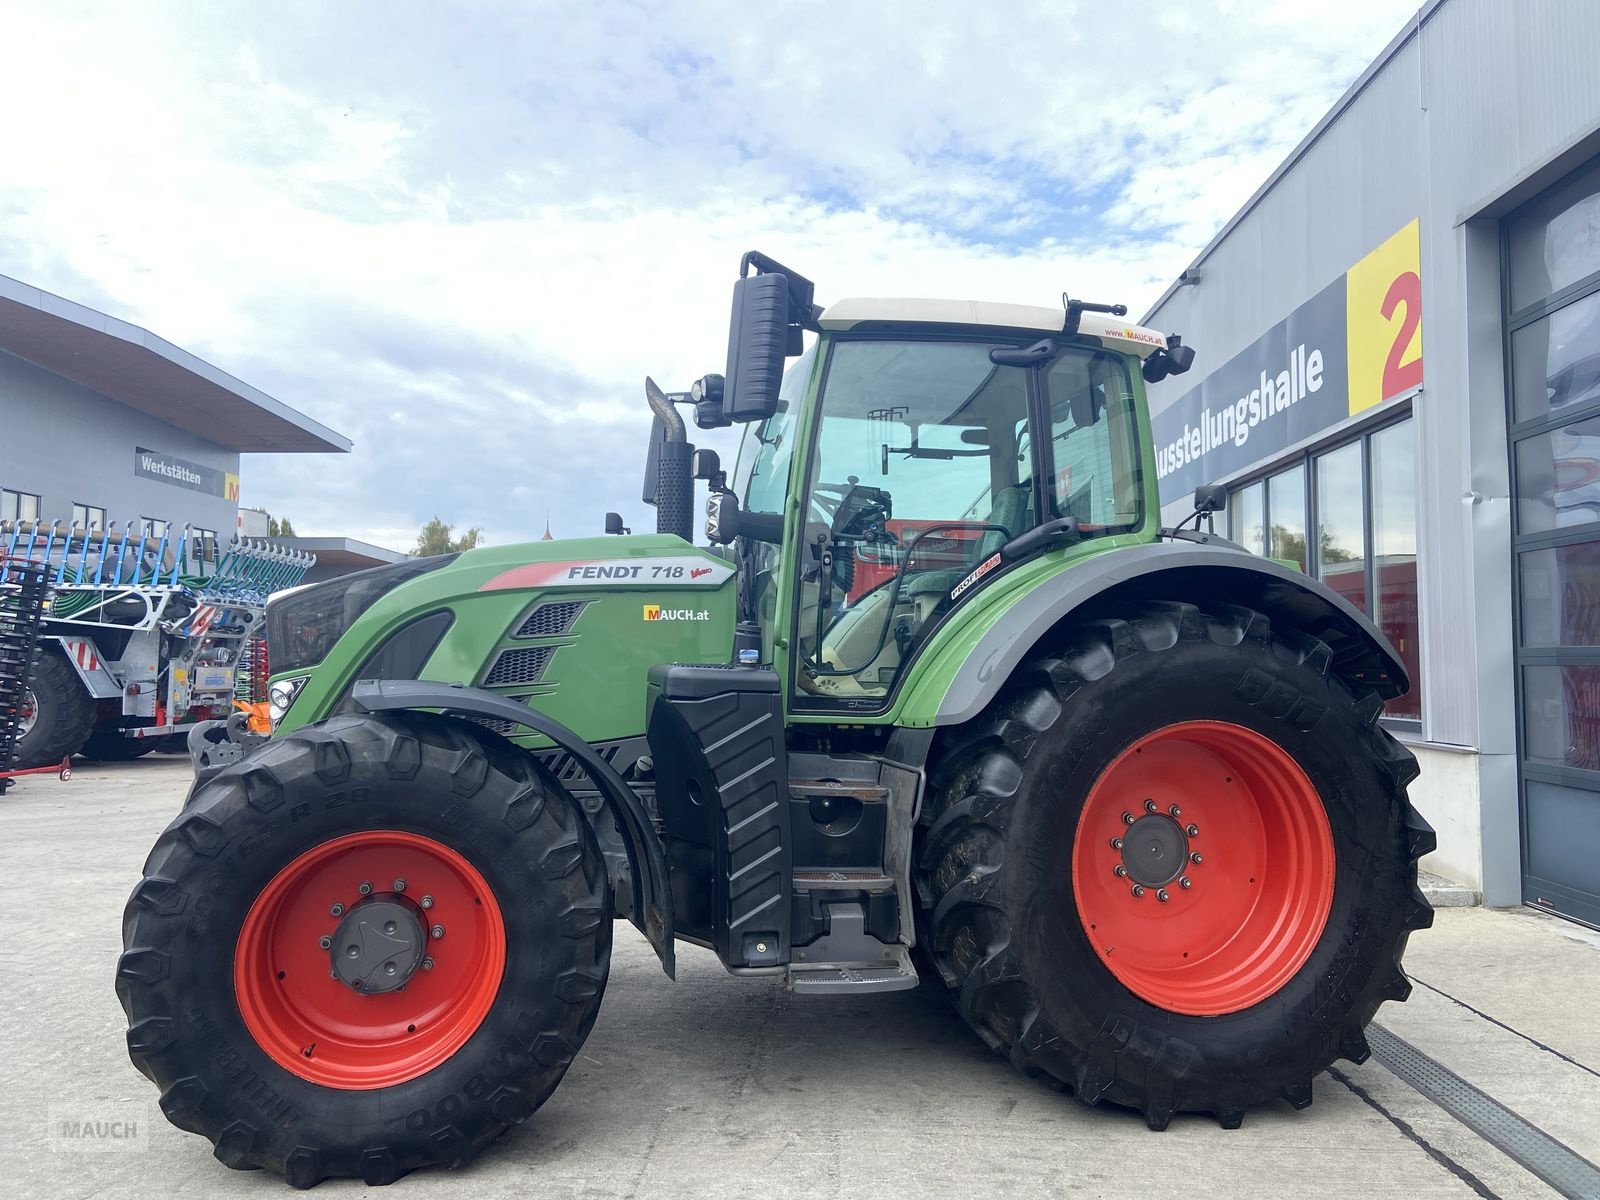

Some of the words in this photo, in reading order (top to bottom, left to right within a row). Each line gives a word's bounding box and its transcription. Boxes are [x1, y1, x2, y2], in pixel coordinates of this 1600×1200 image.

[1380, 271, 1423, 400] 2
[141, 455, 201, 485] Werkstätten
[568, 566, 643, 580] FENDT
[651, 566, 685, 579] 718
[648, 609, 710, 621] MAUCH.at
